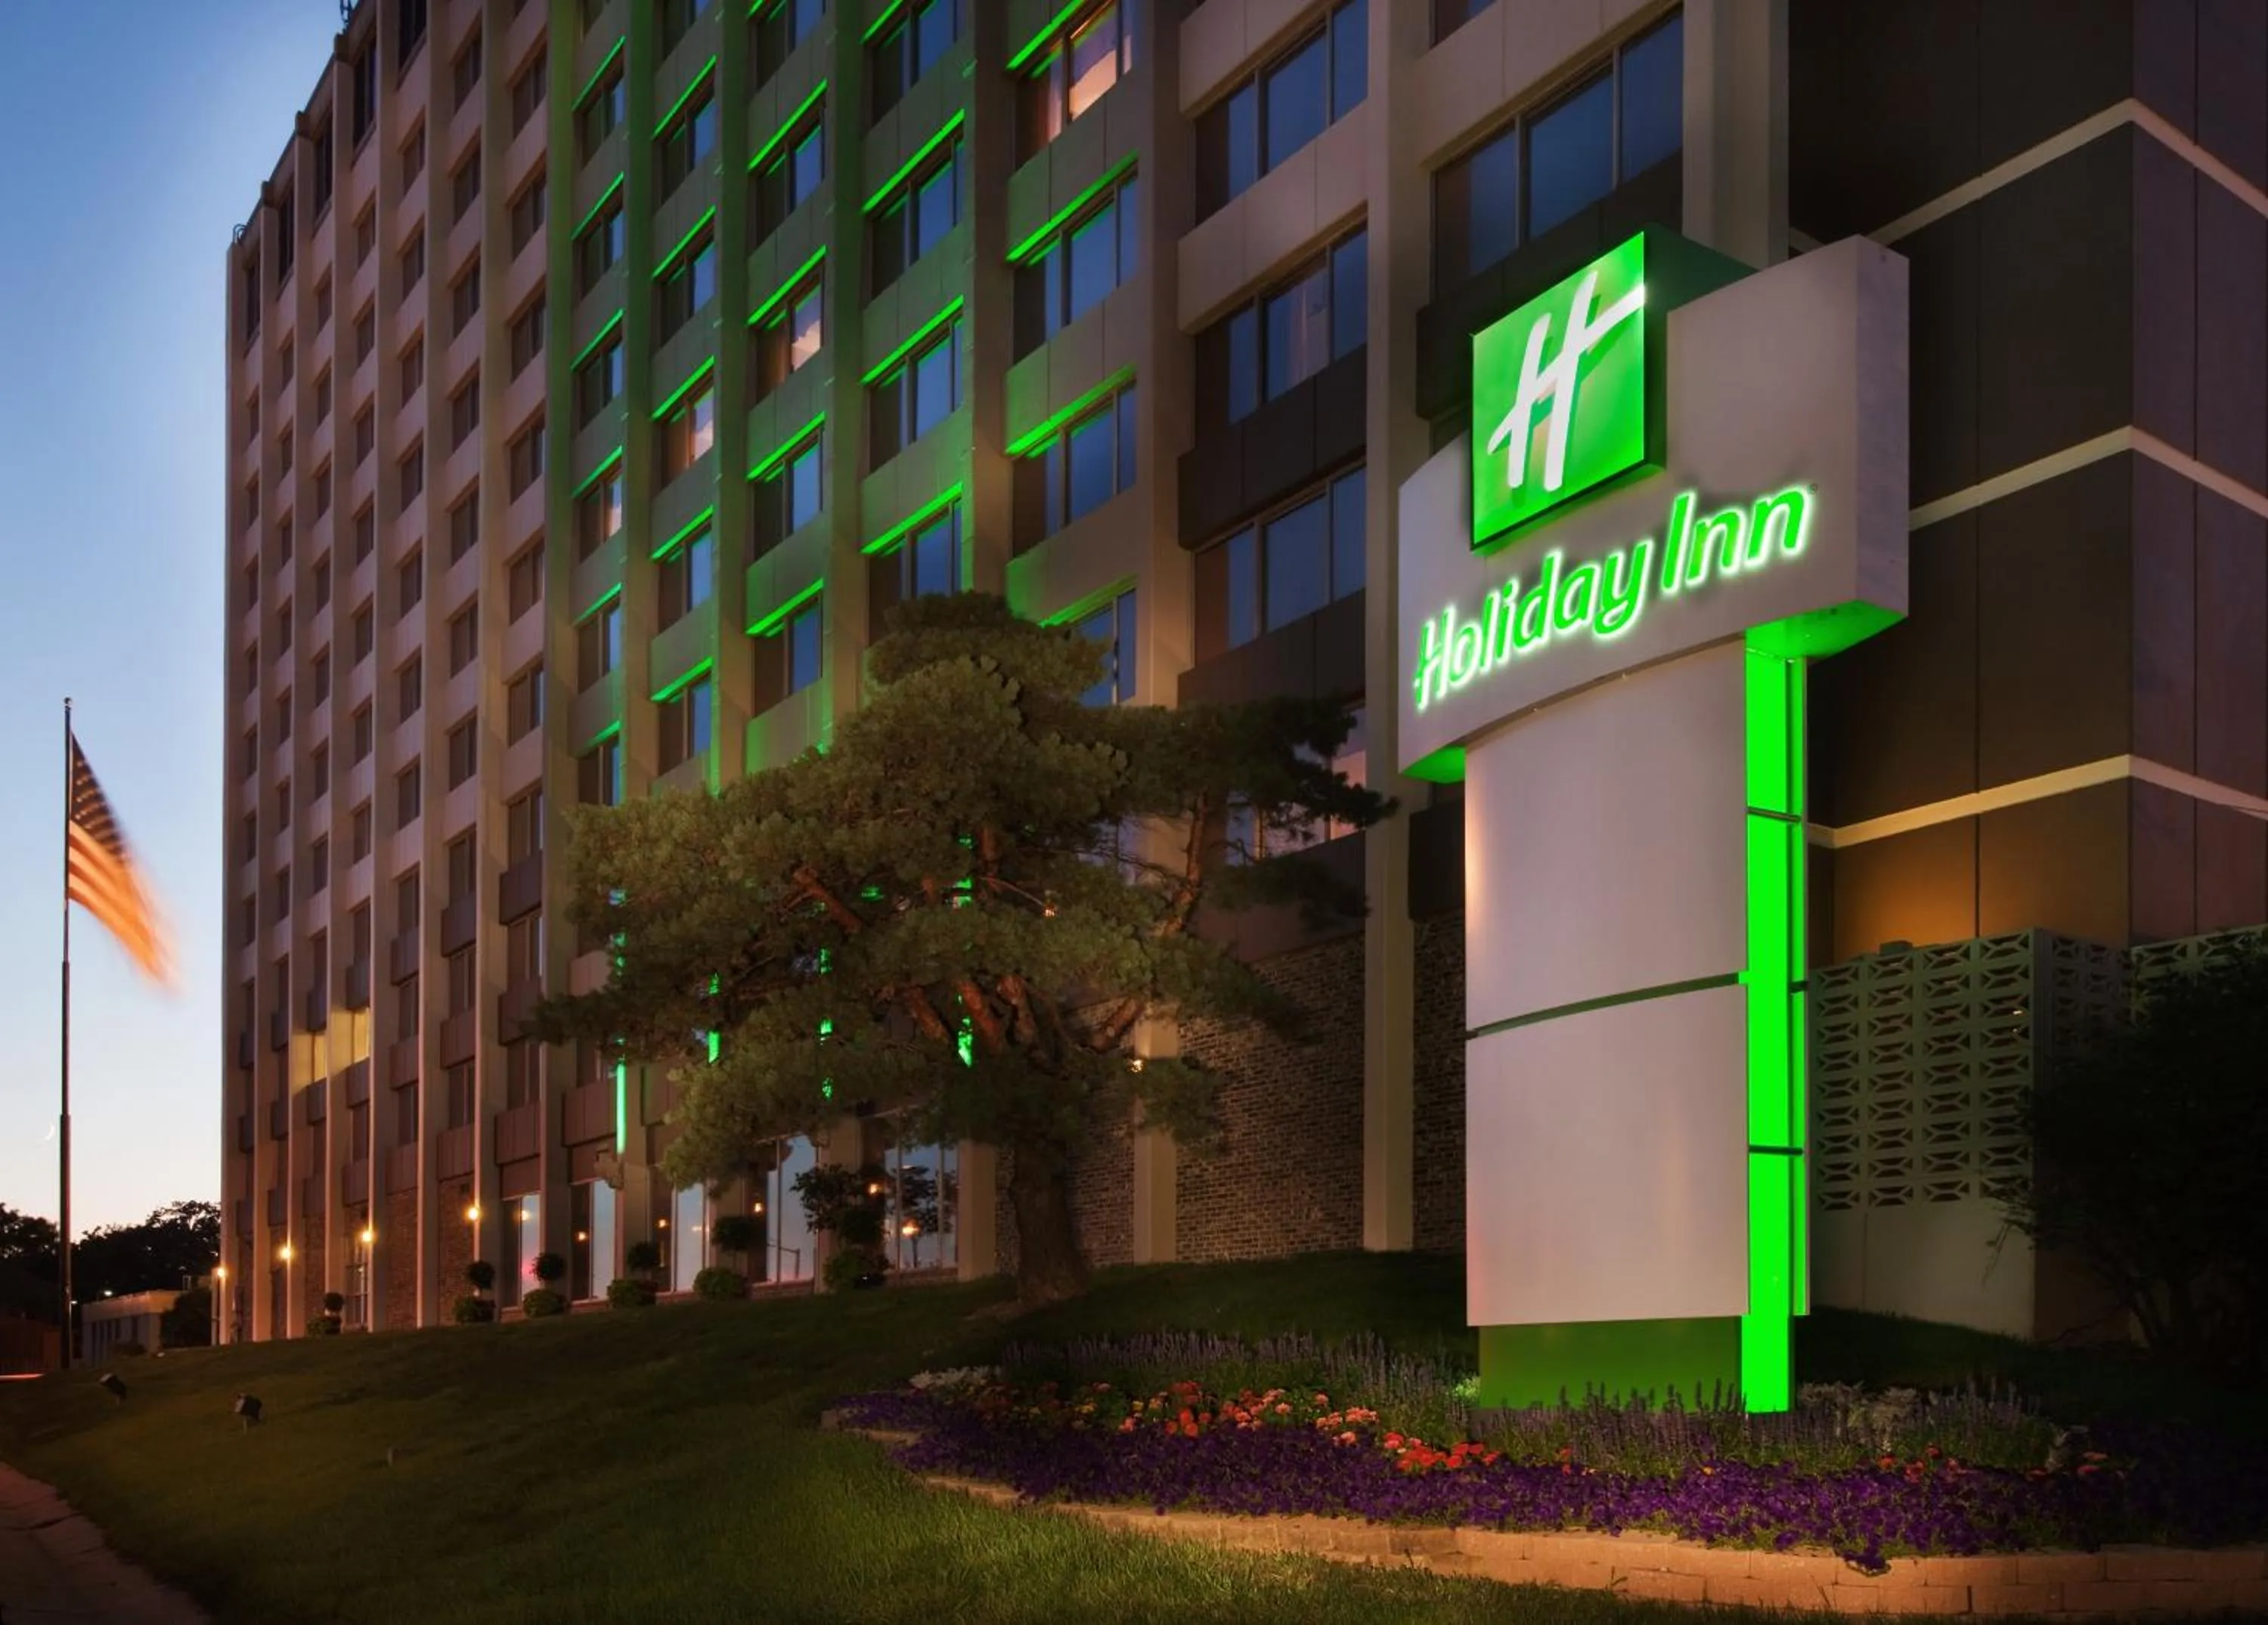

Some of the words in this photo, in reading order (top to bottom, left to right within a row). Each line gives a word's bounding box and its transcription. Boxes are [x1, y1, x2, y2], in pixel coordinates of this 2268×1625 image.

[1486, 271, 1646, 491] H
[1413, 537, 1654, 713] Holiday
[1662, 485, 1811, 595] Inn
